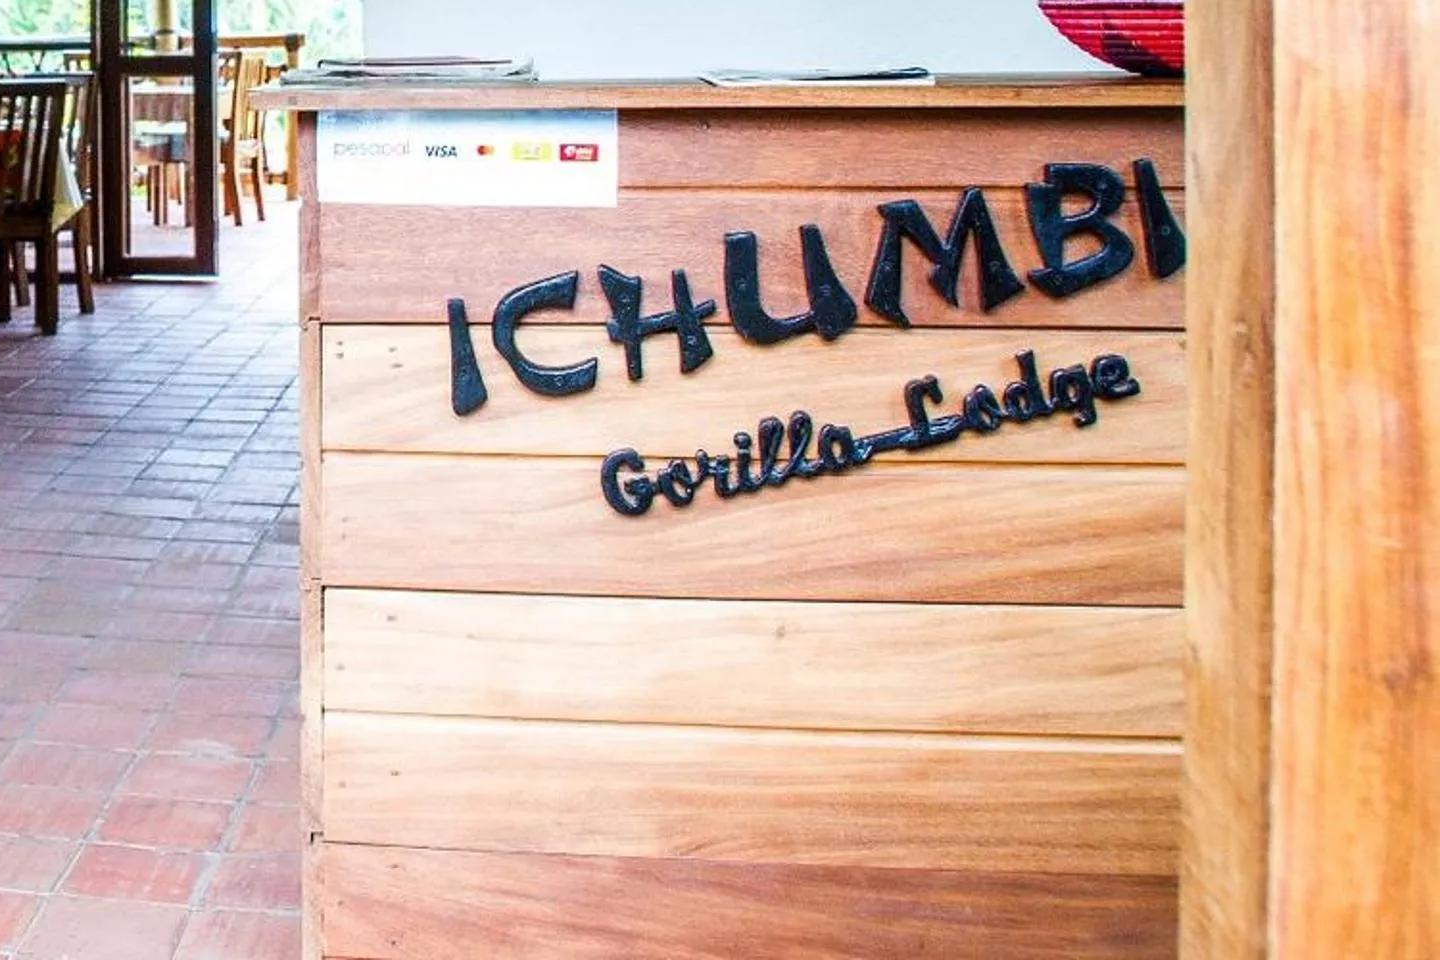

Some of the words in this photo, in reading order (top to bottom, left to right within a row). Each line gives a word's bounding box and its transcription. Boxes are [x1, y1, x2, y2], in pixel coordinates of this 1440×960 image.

[425, 145, 458, 159] VISA
[447, 157, 1186, 416] ICHUMBI
[600, 409, 866, 517] Gorilla
[866, 348, 1140, 451] Lodge
